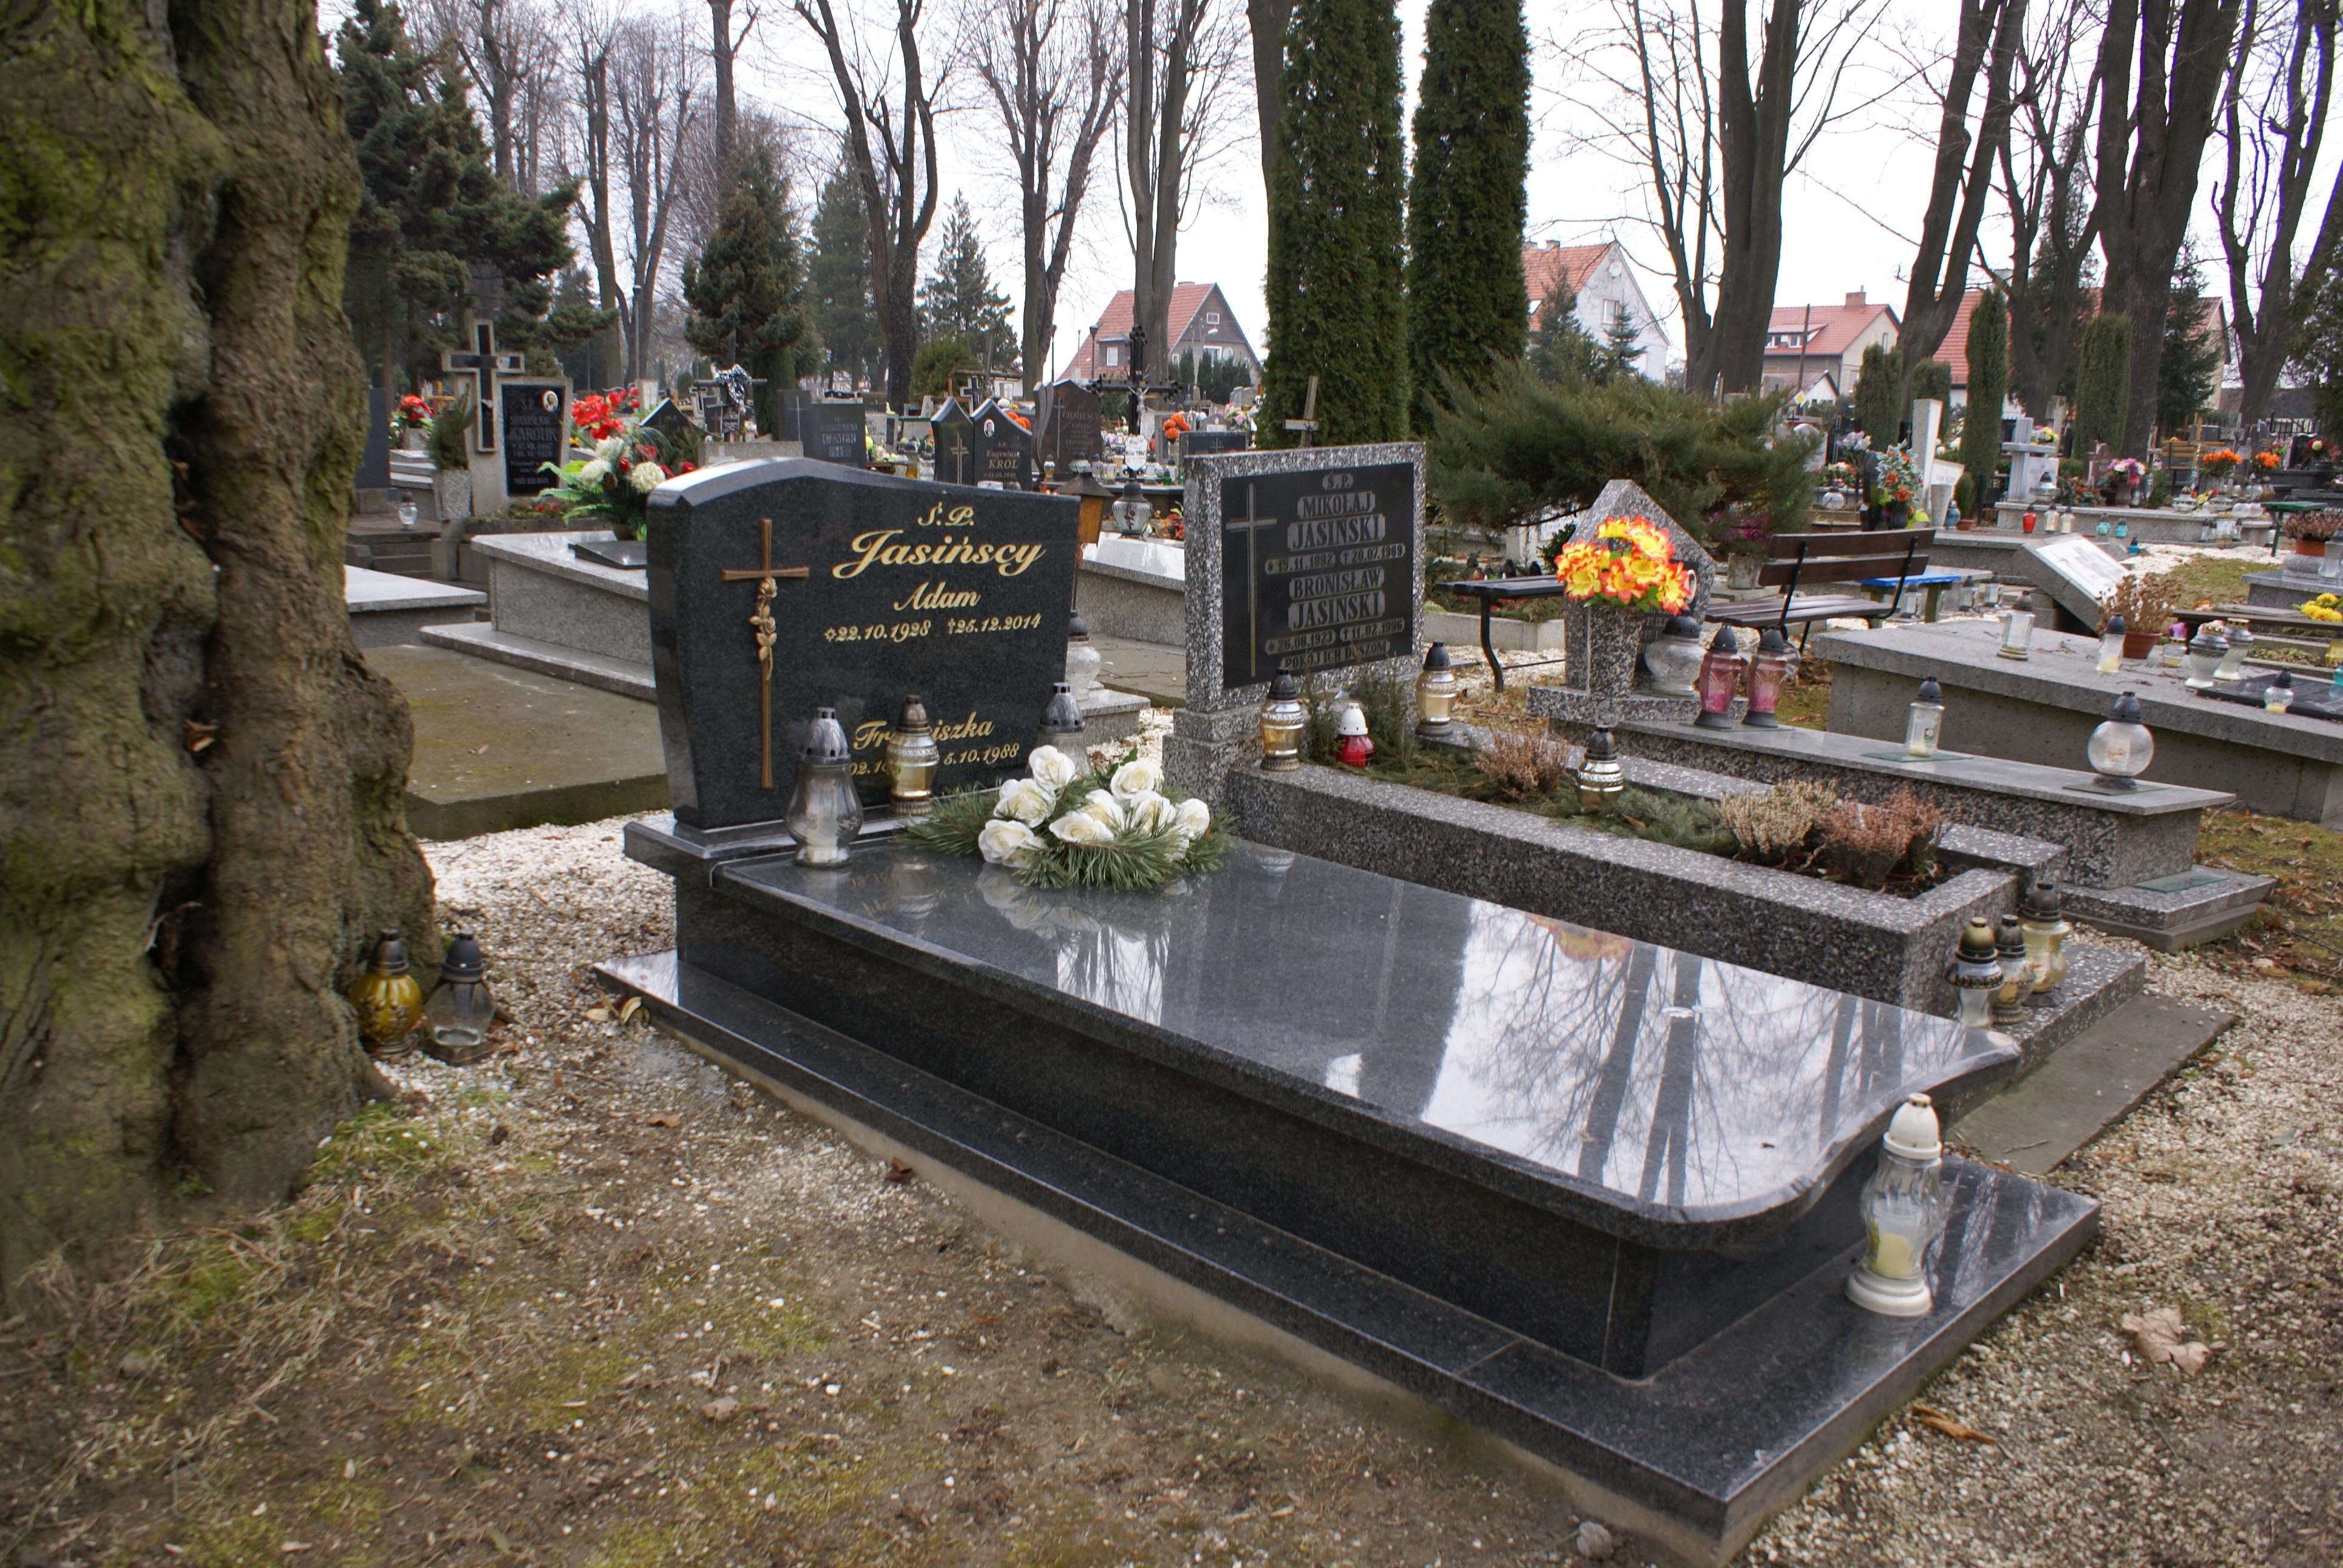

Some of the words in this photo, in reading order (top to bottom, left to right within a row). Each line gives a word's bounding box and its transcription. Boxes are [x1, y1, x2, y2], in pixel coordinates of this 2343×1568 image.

[1303, 492, 1371, 517] MIKOŁAJ
[832, 529, 1047, 579] Jasińscy
[893, 581, 981, 611] Adam
[1294, 568, 1381, 598] BRONISŁAW
[1323, 647, 1341, 661] ICH
